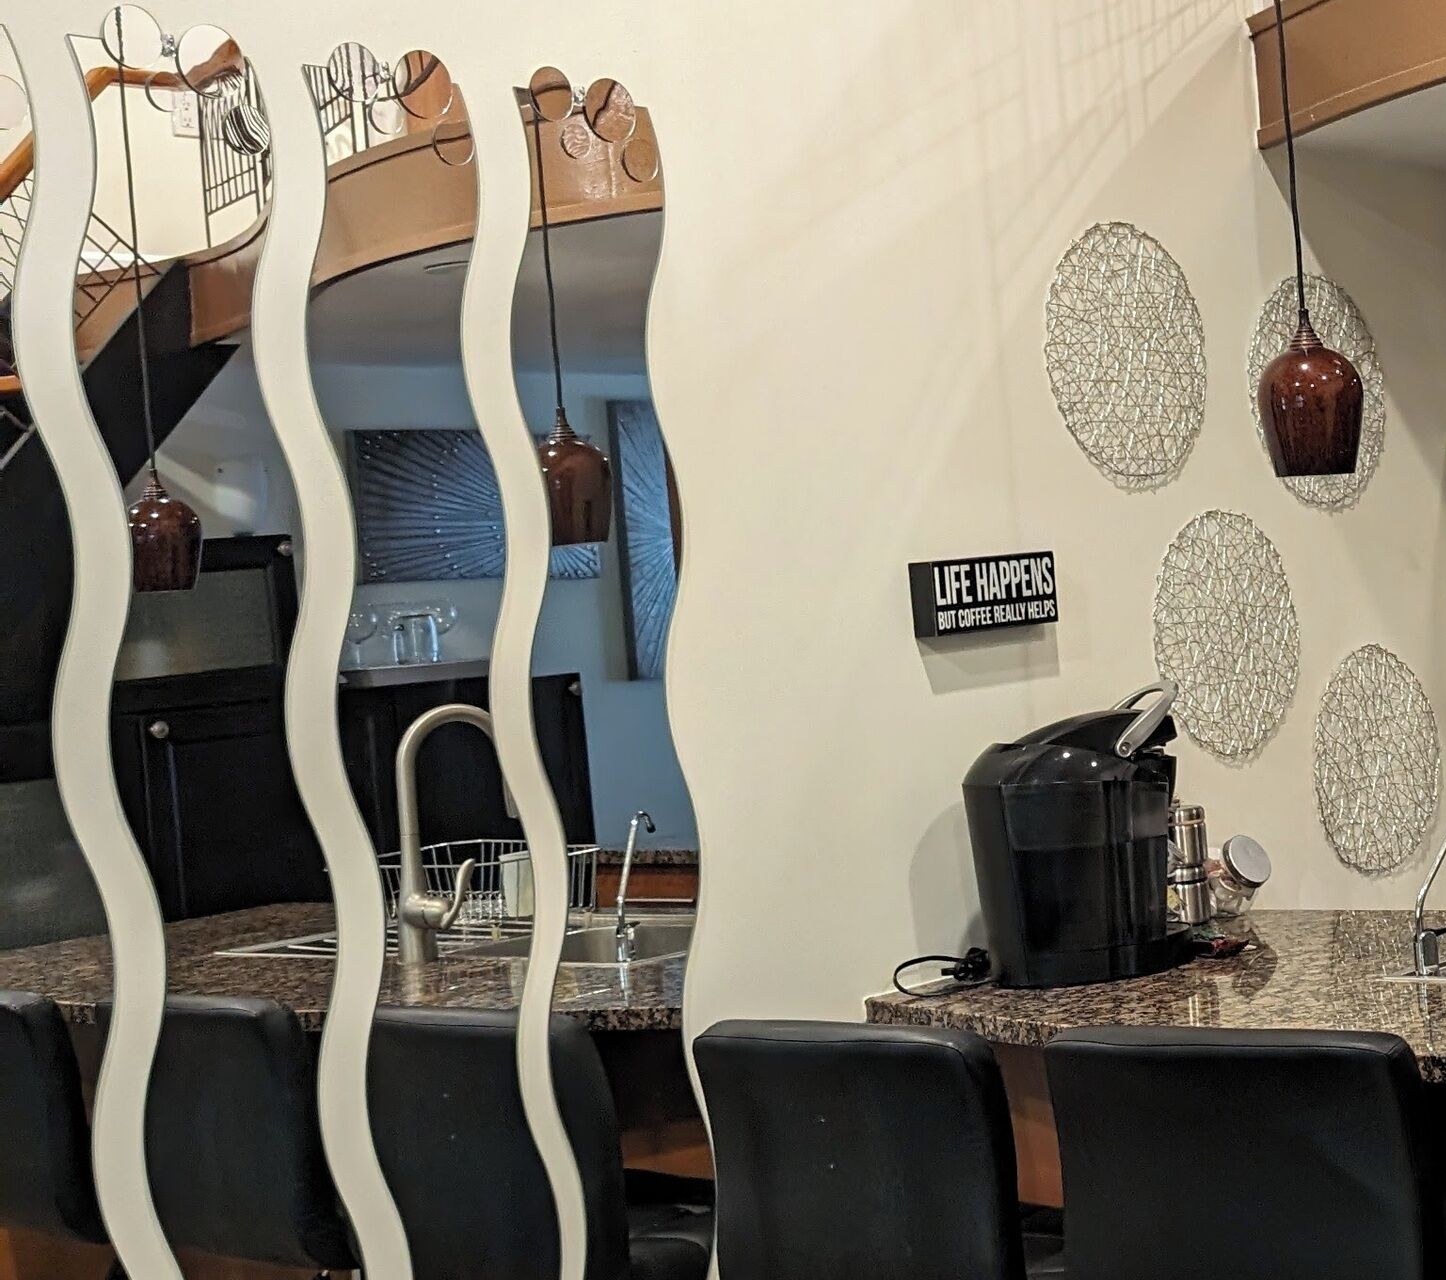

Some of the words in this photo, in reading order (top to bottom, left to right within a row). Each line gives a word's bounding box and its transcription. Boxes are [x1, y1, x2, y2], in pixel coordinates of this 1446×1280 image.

[933, 564, 973, 606] LIFE
[975, 556, 1054, 602] HAPPENS
[937, 610, 957, 631] BUT
[958, 606, 993, 628] COFFEE
[993, 602, 1026, 623] REALLY
[1027, 599, 1055, 619] HELPS
